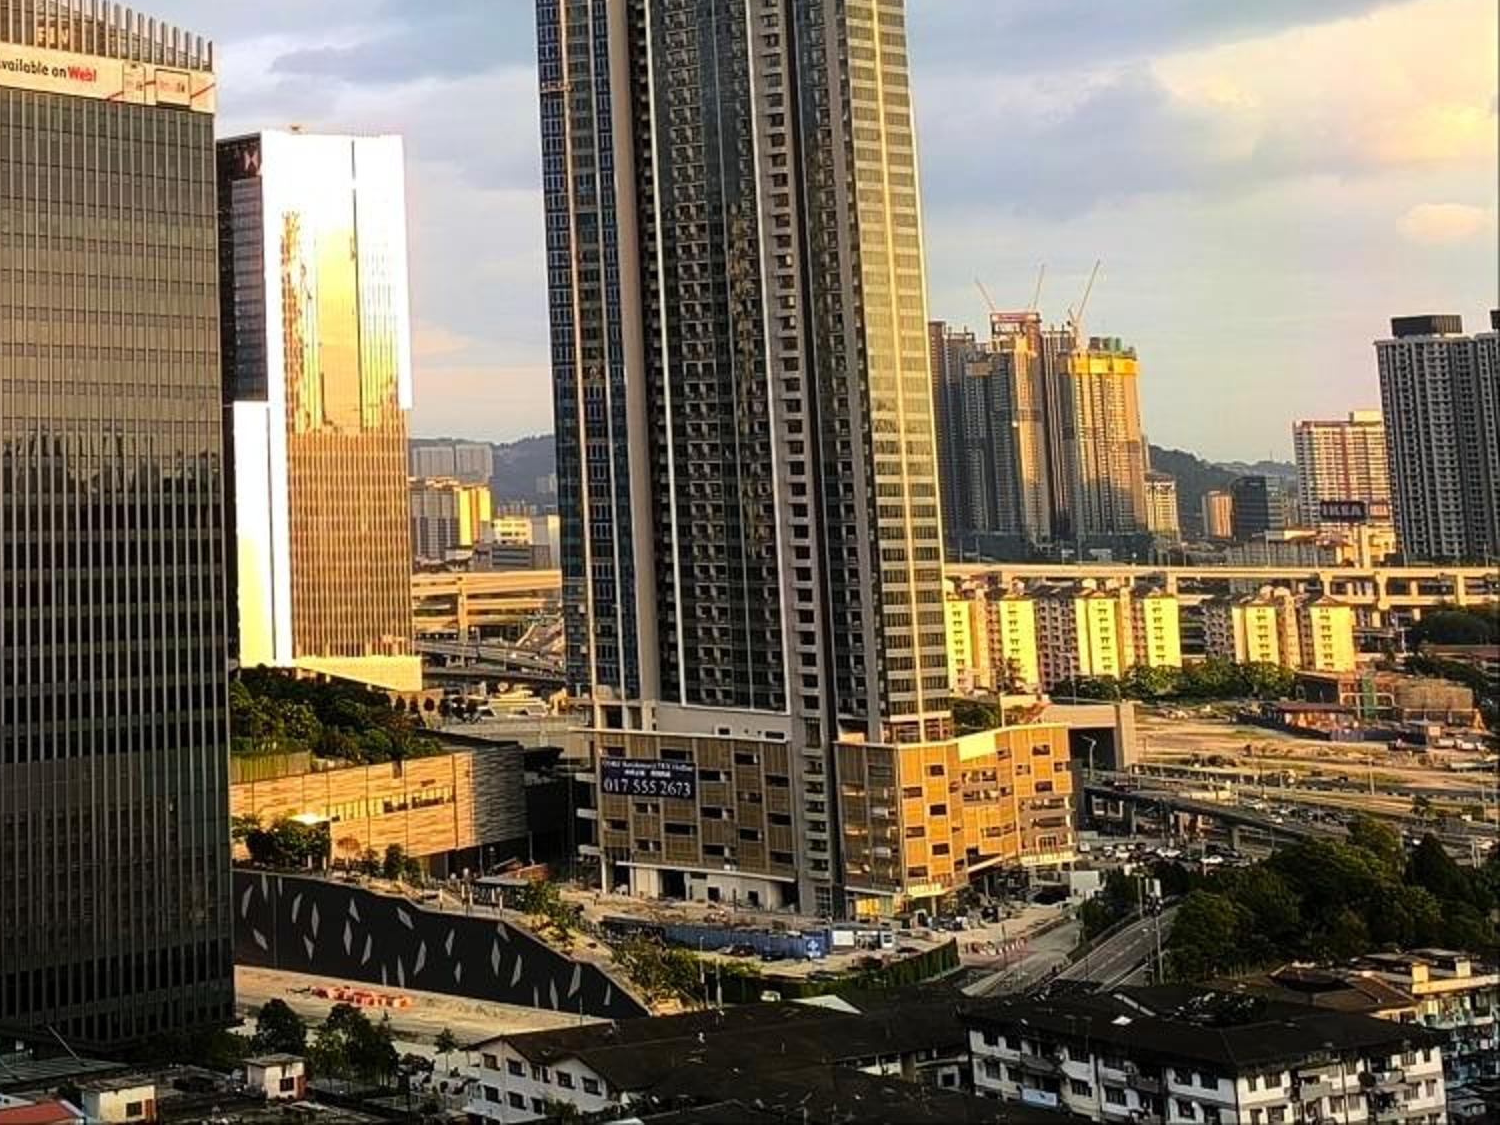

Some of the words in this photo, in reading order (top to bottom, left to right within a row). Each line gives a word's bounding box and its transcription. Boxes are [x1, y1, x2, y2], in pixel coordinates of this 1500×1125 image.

[51, 66, 67, 78] on
[603, 777, 629, 792] 017
[632, 778, 657, 794] 555
[659, 780, 691, 797] 2673
